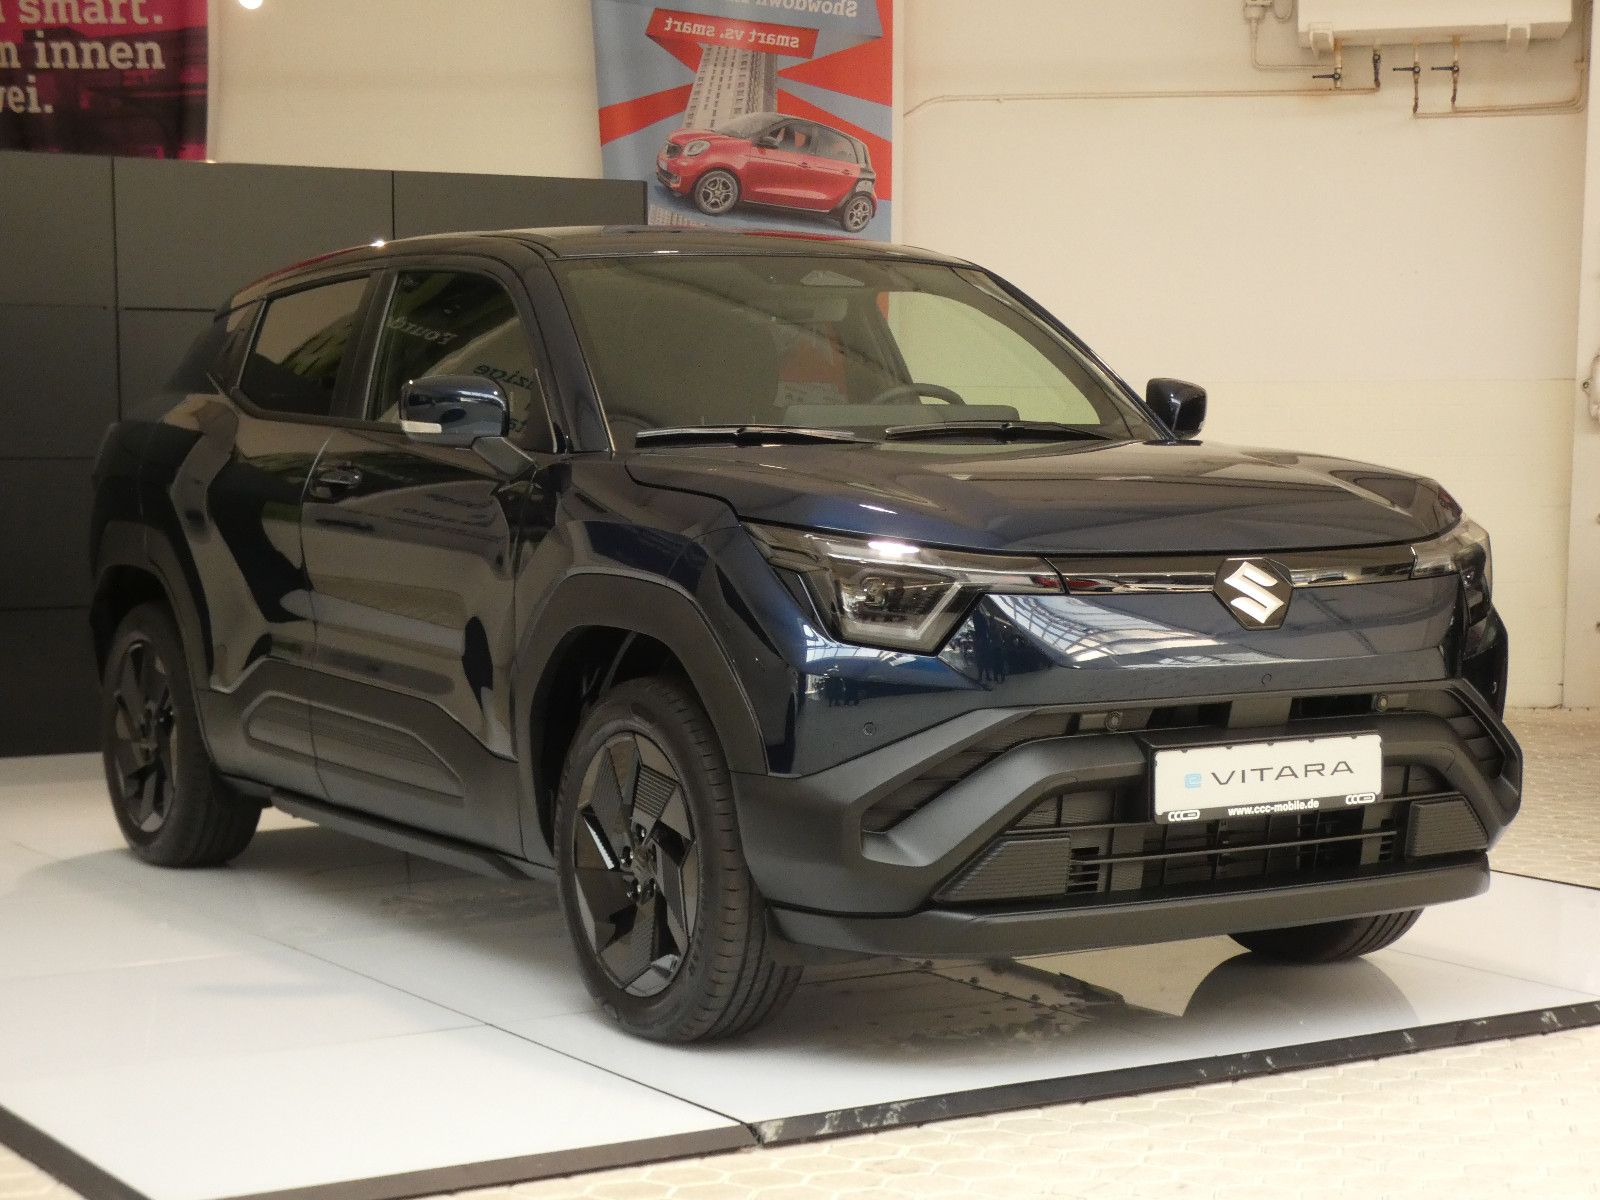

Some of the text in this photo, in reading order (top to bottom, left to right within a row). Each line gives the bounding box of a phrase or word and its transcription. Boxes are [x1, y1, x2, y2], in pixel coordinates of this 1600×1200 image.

[18, 0, 163, 25] smart.
[34, 30, 166, 70] innen
[1211, 760, 1354, 786] VITARA
[1227, 798, 1320, 817] www.ccc-mobile.de
